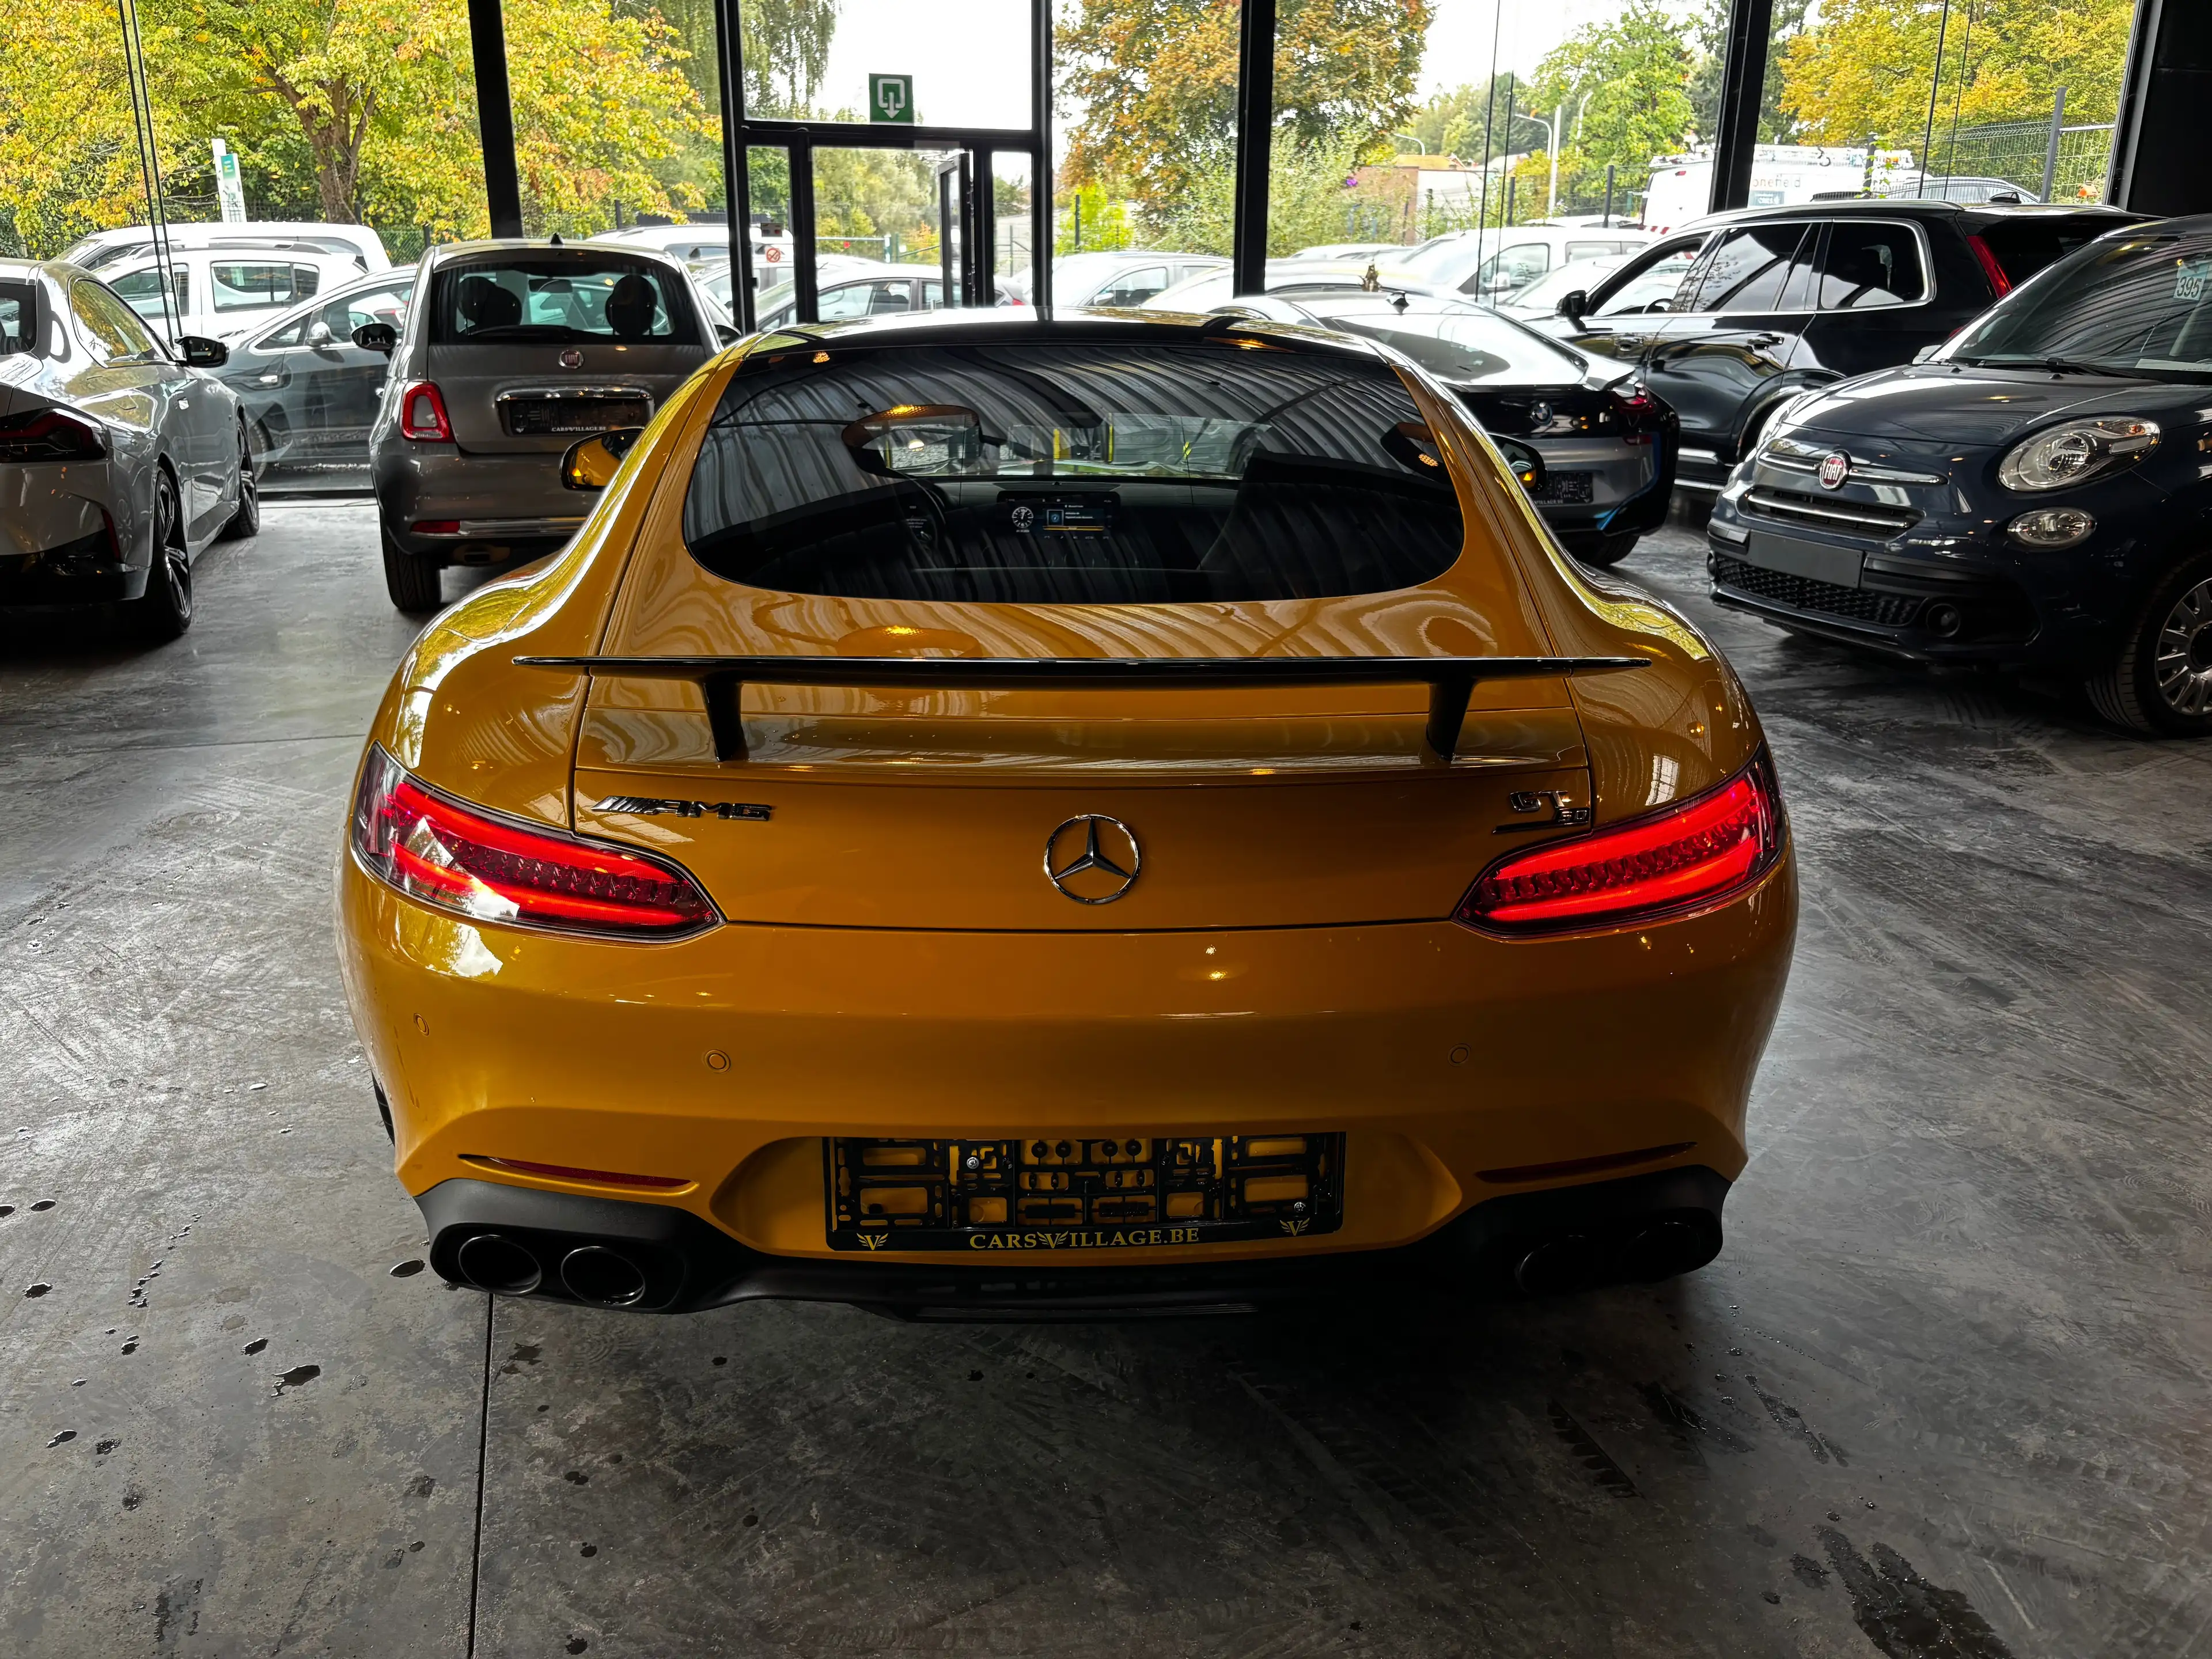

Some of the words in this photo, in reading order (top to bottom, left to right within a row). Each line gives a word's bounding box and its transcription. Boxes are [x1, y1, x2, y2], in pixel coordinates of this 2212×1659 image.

[2177, 276, 2202, 298] 395
[565, 354, 578, 363] FIAT
[1824, 463, 1843, 480] FIAT
[643, 798, 770, 821] AMG
[1509, 790, 1569, 812] GT
[970, 1228, 1199, 1249] CARSVILLAGE.BE
